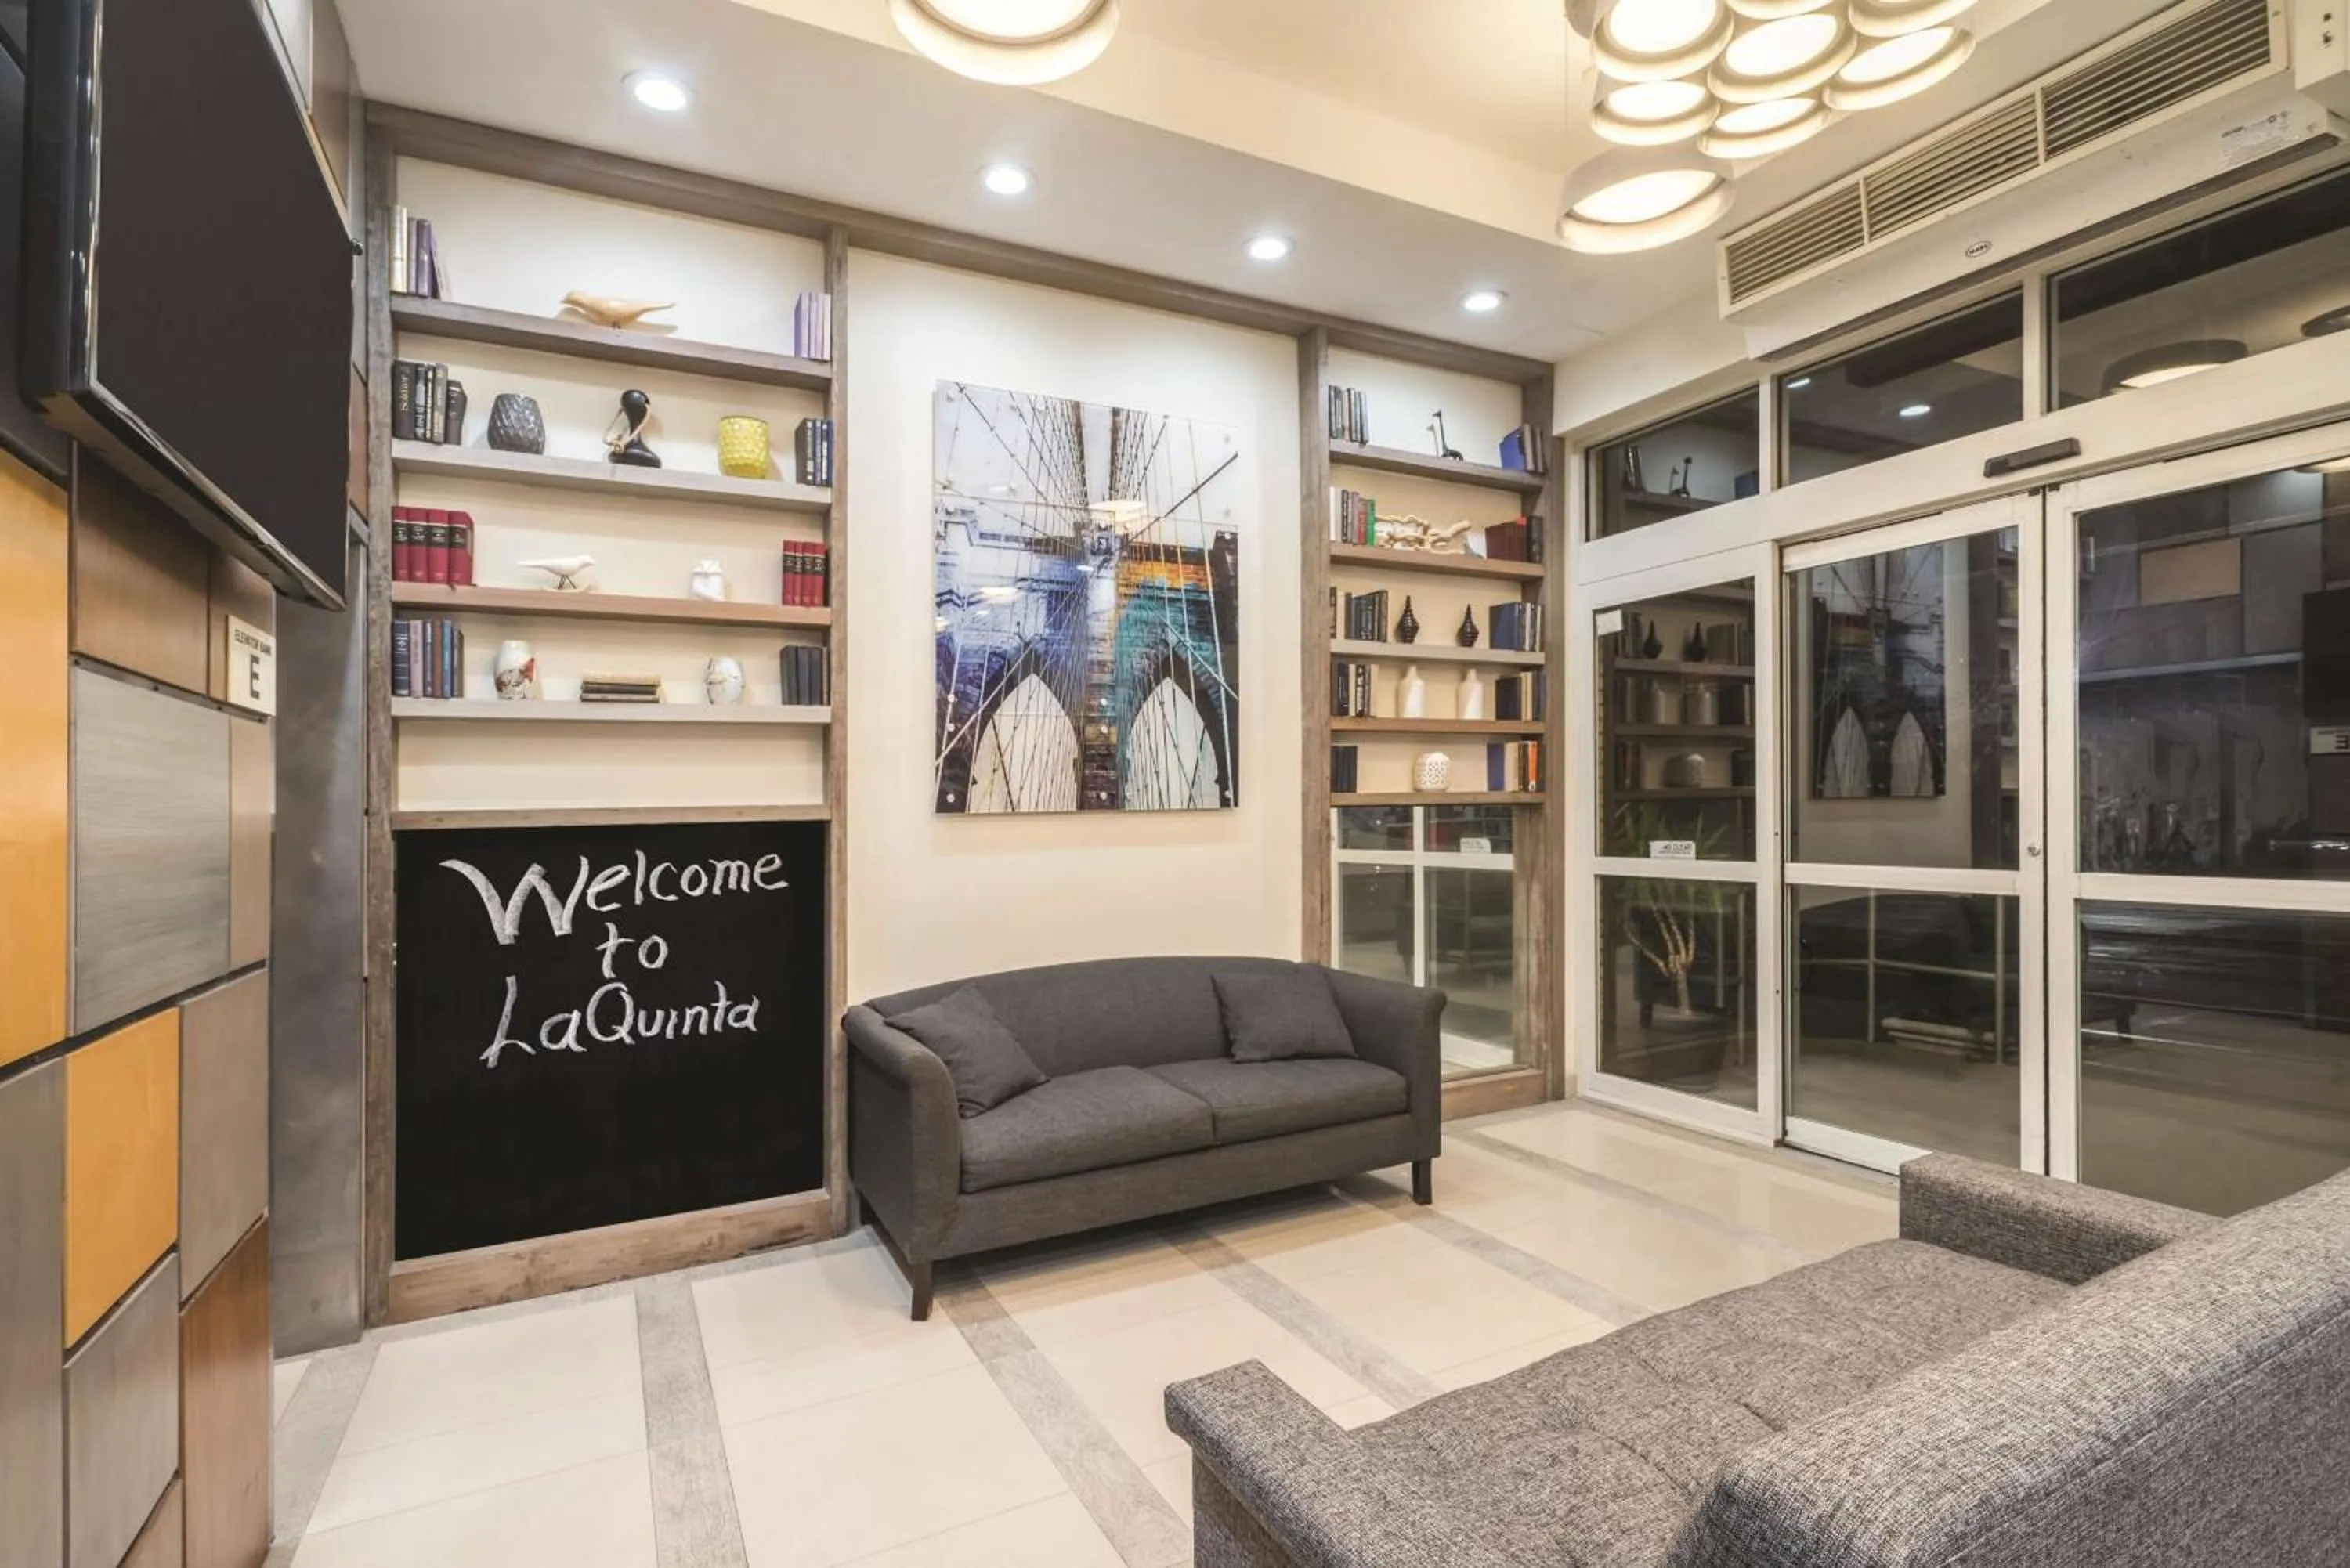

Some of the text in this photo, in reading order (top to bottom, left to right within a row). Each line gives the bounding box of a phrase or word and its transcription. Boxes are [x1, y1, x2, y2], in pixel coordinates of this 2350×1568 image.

[250, 654, 260, 699] E
[439, 849, 788, 945] Welcome
[595, 922, 668, 978] to
